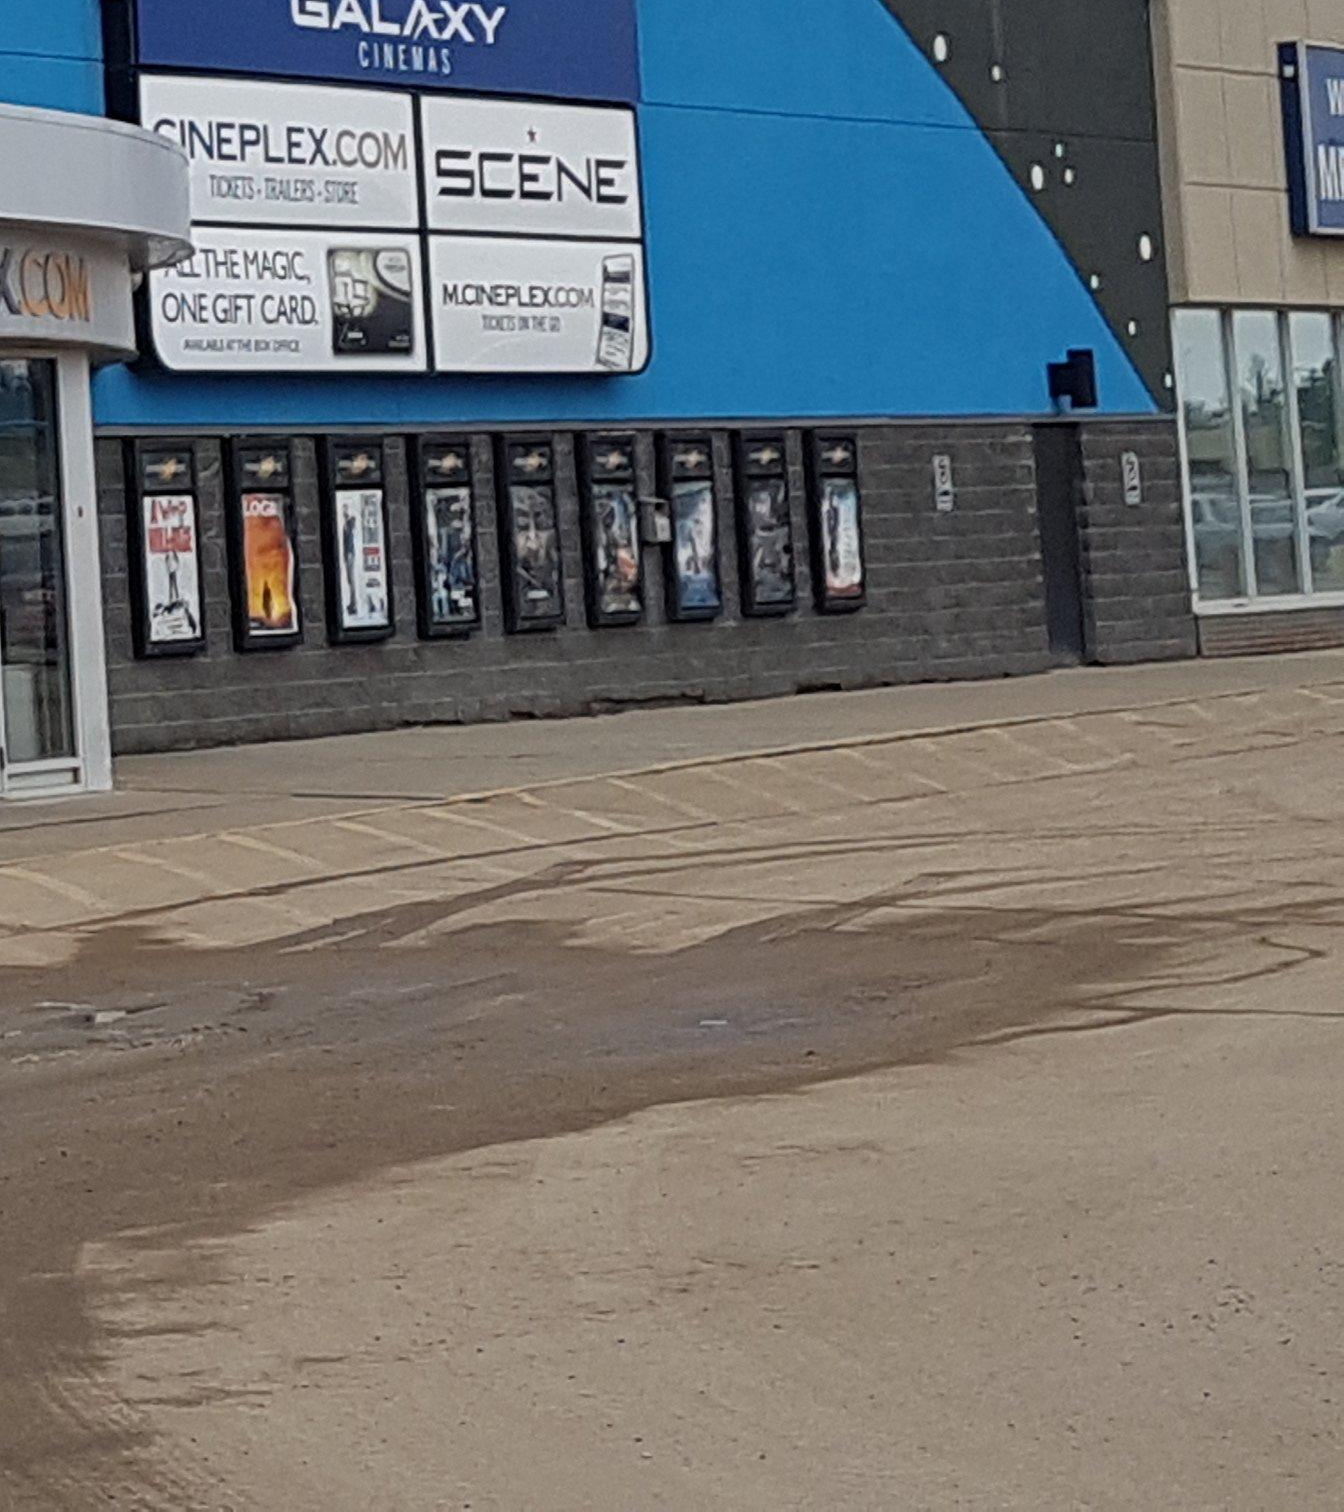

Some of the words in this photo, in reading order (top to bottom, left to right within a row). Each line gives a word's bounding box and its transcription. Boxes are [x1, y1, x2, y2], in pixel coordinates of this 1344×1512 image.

[357, 40, 453, 76] CINEMAS
[209, 174, 255, 200] TICKETS
[324, 179, 360, 205] STORE
[433, 148, 630, 206] SCENE
[199, 248, 241, 279] THE
[243, 249, 311, 284] MAGIC,
[162, 292, 209, 324] ONE
[212, 294, 256, 325] GIFT
[261, 295, 319, 326] CARD.
[442, 283, 595, 309] M.CINEPLEX.COM
